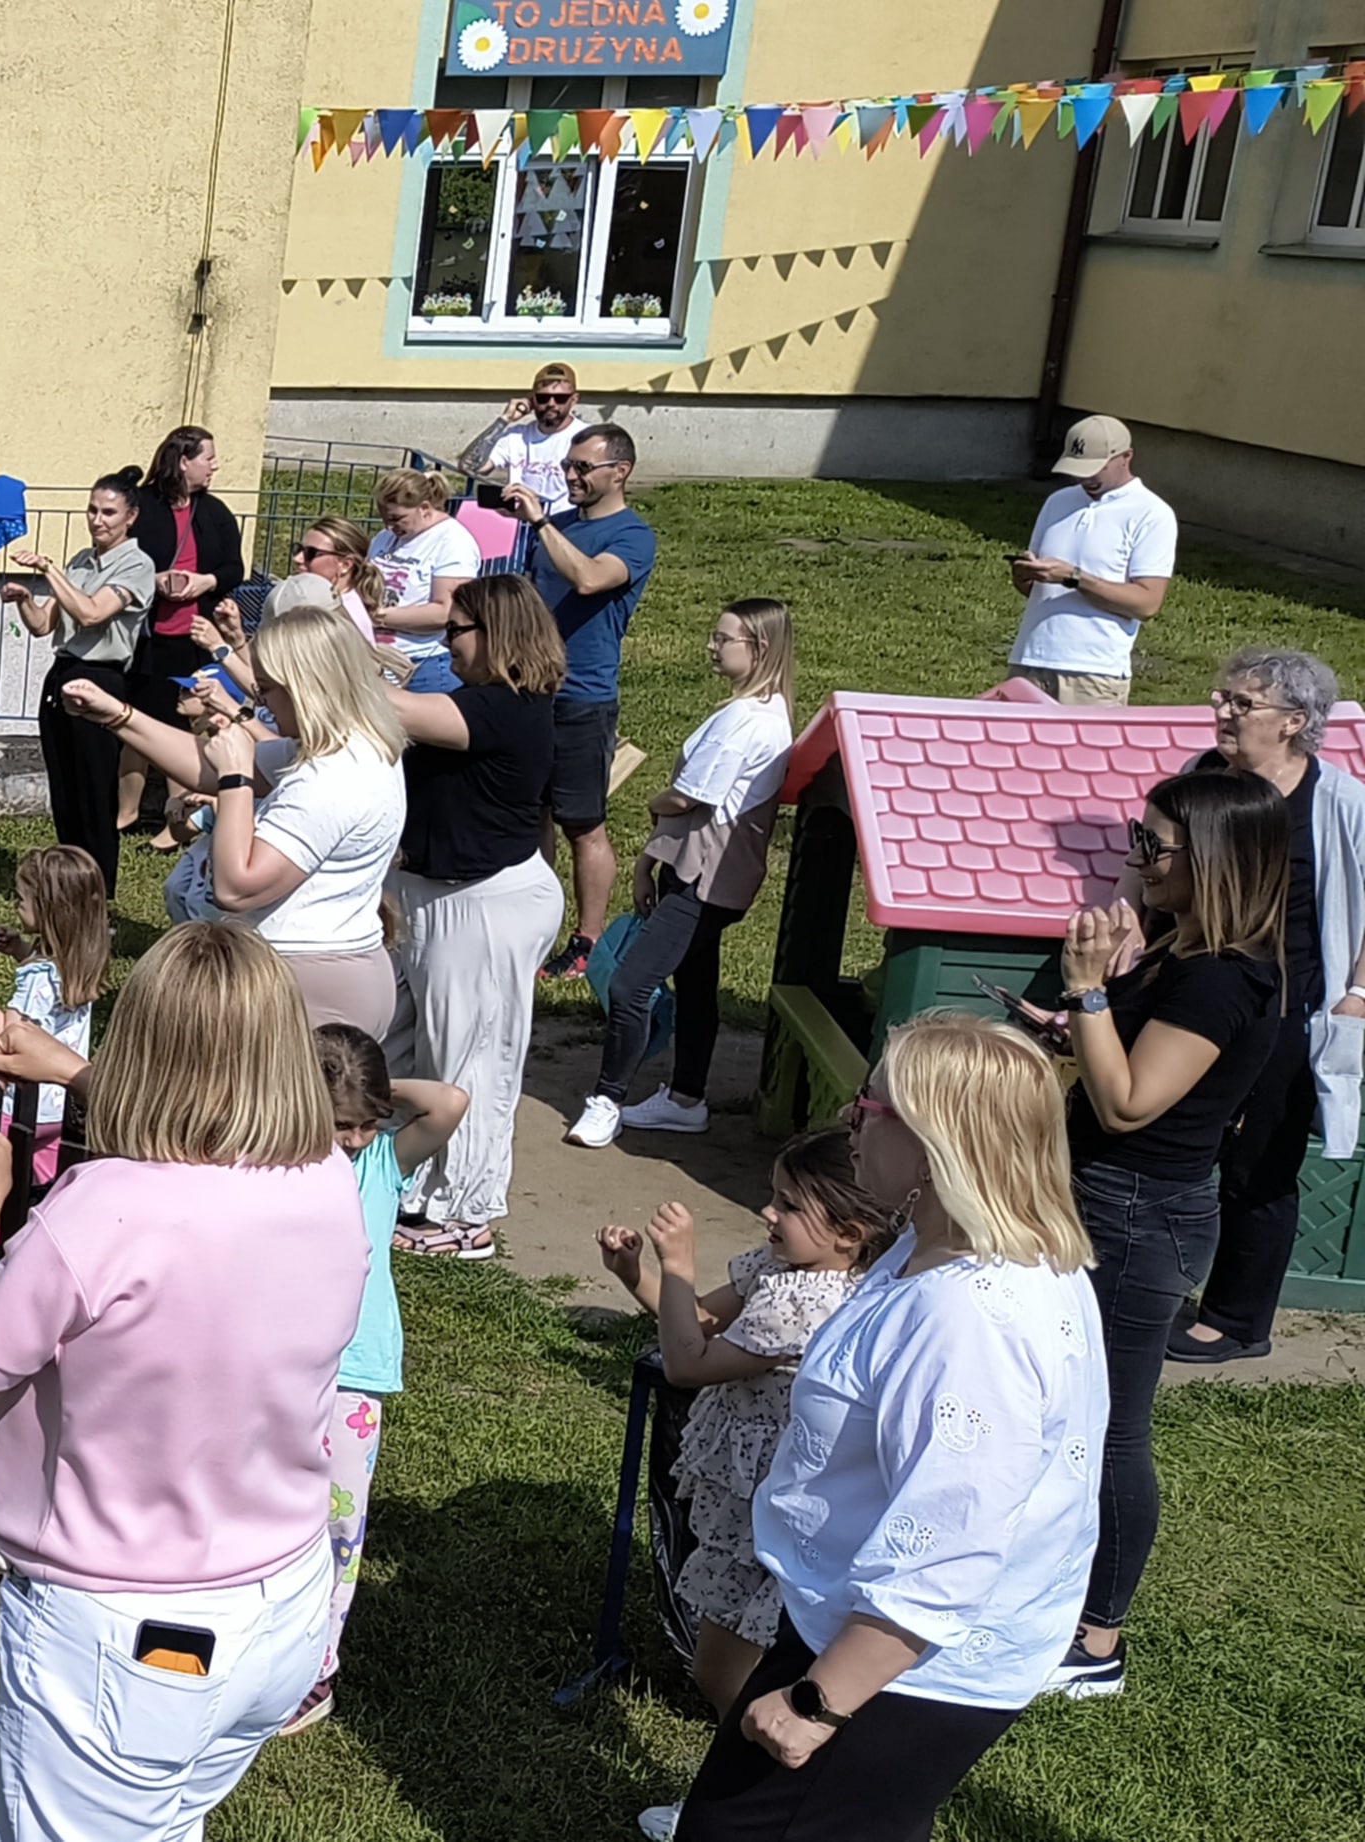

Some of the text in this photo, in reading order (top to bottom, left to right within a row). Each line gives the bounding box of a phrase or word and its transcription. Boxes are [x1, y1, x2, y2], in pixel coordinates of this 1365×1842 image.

[492, 0, 666, 28] TO JEDNA
[507, 31, 683, 65] DRUŻYNA
